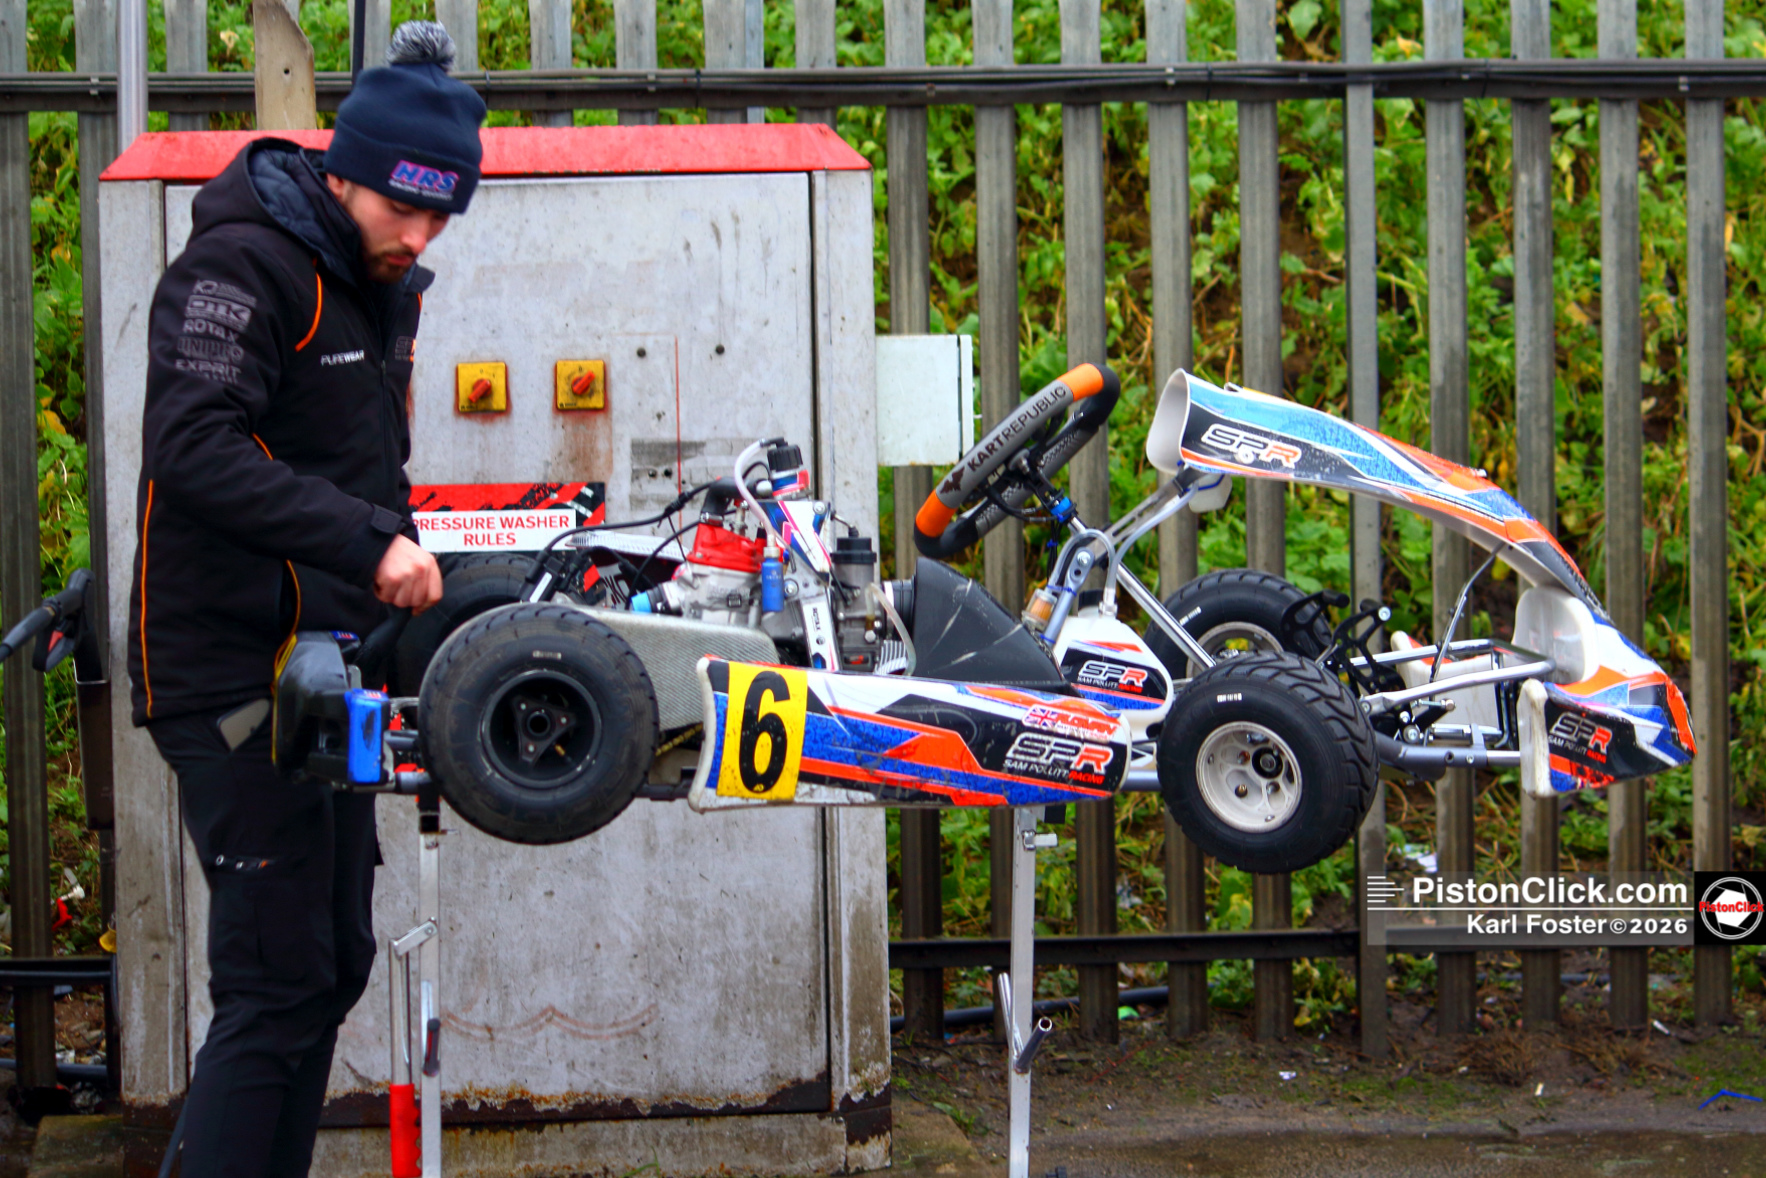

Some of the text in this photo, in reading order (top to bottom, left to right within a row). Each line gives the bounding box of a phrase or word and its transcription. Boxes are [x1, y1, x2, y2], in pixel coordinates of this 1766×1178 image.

[183, 318, 239, 343] ROTAX
[967, 386, 1066, 472] KARTREPUBLIC
[1201, 423, 1302, 469] SPR
[464, 532, 516, 546] RULES
[500, 515, 569, 529] WASHER
[1078, 660, 1148, 687] SPR
[739, 670, 790, 793] 6
[1549, 711, 1613, 755] SPR
[1006, 732, 1114, 775] SPR
[1003, 758, 1028, 771] SAM
[1068, 770, 1106, 785] RACING
